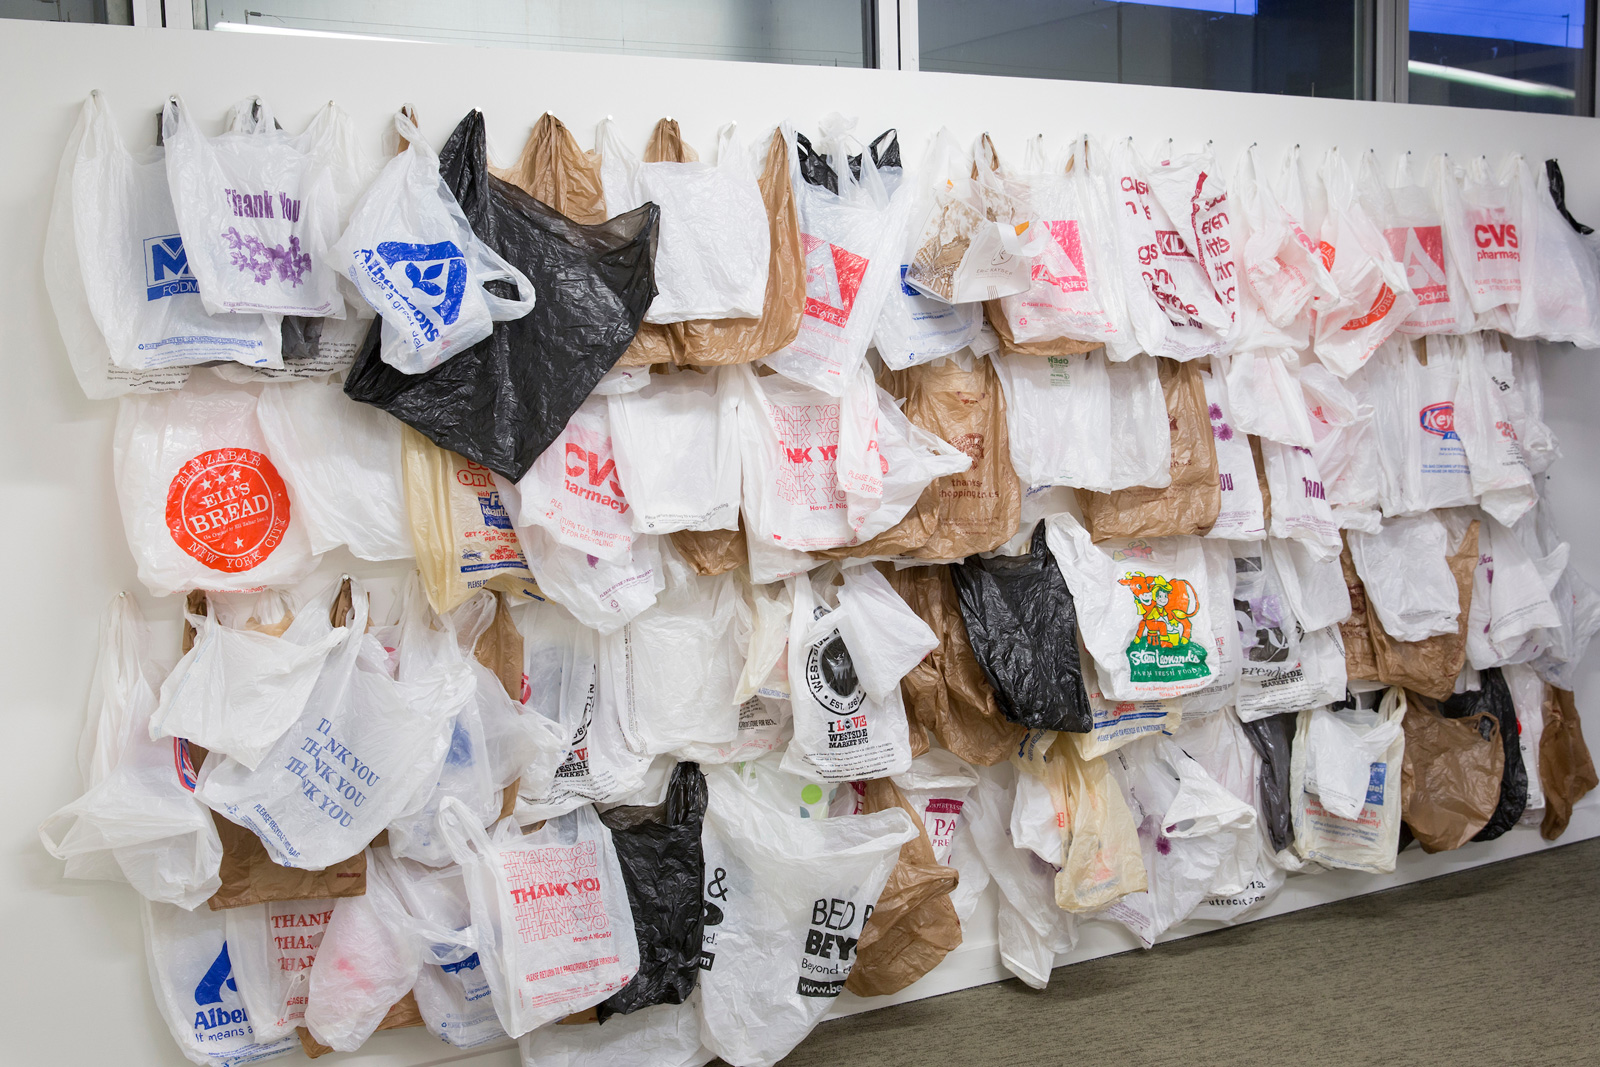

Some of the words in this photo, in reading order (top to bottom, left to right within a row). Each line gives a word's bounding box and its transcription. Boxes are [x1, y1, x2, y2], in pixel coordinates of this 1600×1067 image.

[225, 188, 275, 219] Thank
[278, 191, 301, 223] You
[1474, 224, 1519, 249] CVS
[1476, 249, 1521, 262] pharmacy
[815, 404, 841, 419] YO
[204, 450, 261, 467] ZABAR
[457, 469, 487, 487] On
[848, 469, 868, 483] PLEASE
[201, 482, 251, 509] ELI'S
[860, 483, 879, 496] STORE
[188, 494, 270, 535] BREAD
[566, 527, 579, 538] FOR
[226, 550, 264, 569] YORK
[264, 517, 287, 548] CITY
[467, 580, 482, 589] PLEASE
[1129, 650, 1156, 666] Stew
[1155, 649, 1201, 668] Leonard's
[1261, 680, 1289, 688] MARKET
[829, 698, 845, 710] EST.
[827, 721, 836, 733] I
[828, 728, 868, 742] WESTSIDE
[828, 739, 857, 749] MARKET
[350, 756, 381, 787] YOU
[335, 776, 367, 807] YOU
[318, 794, 354, 828] YOU
[253, 803, 273, 825] PLEASE
[288, 846, 301, 858] BAG
[500, 847, 562, 865] THANK
[561, 839, 597, 861] YOU
[504, 859, 563, 877] THANK
[507, 872, 567, 891] THANK
[706, 867, 729, 902] &
[510, 882, 572, 904] THANK
[271, 909, 334, 928] THANK
[515, 906, 580, 930] THANK
[811, 897, 856, 931] BED
[518, 919, 583, 944] THANK
[804, 928, 859, 961] BEY
[526, 973, 539, 982] PLEASE
[539, 970, 555, 980] RETURN
[555, 967, 560, 975] TO
[563, 960, 589, 972] PARTICIPATING
[588, 958, 599, 968] STORE
[801, 957, 839, 975] Beyond
[195, 1033, 204, 1043] It
[208, 1027, 245, 1042] means
[247, 1025, 254, 1034] a
